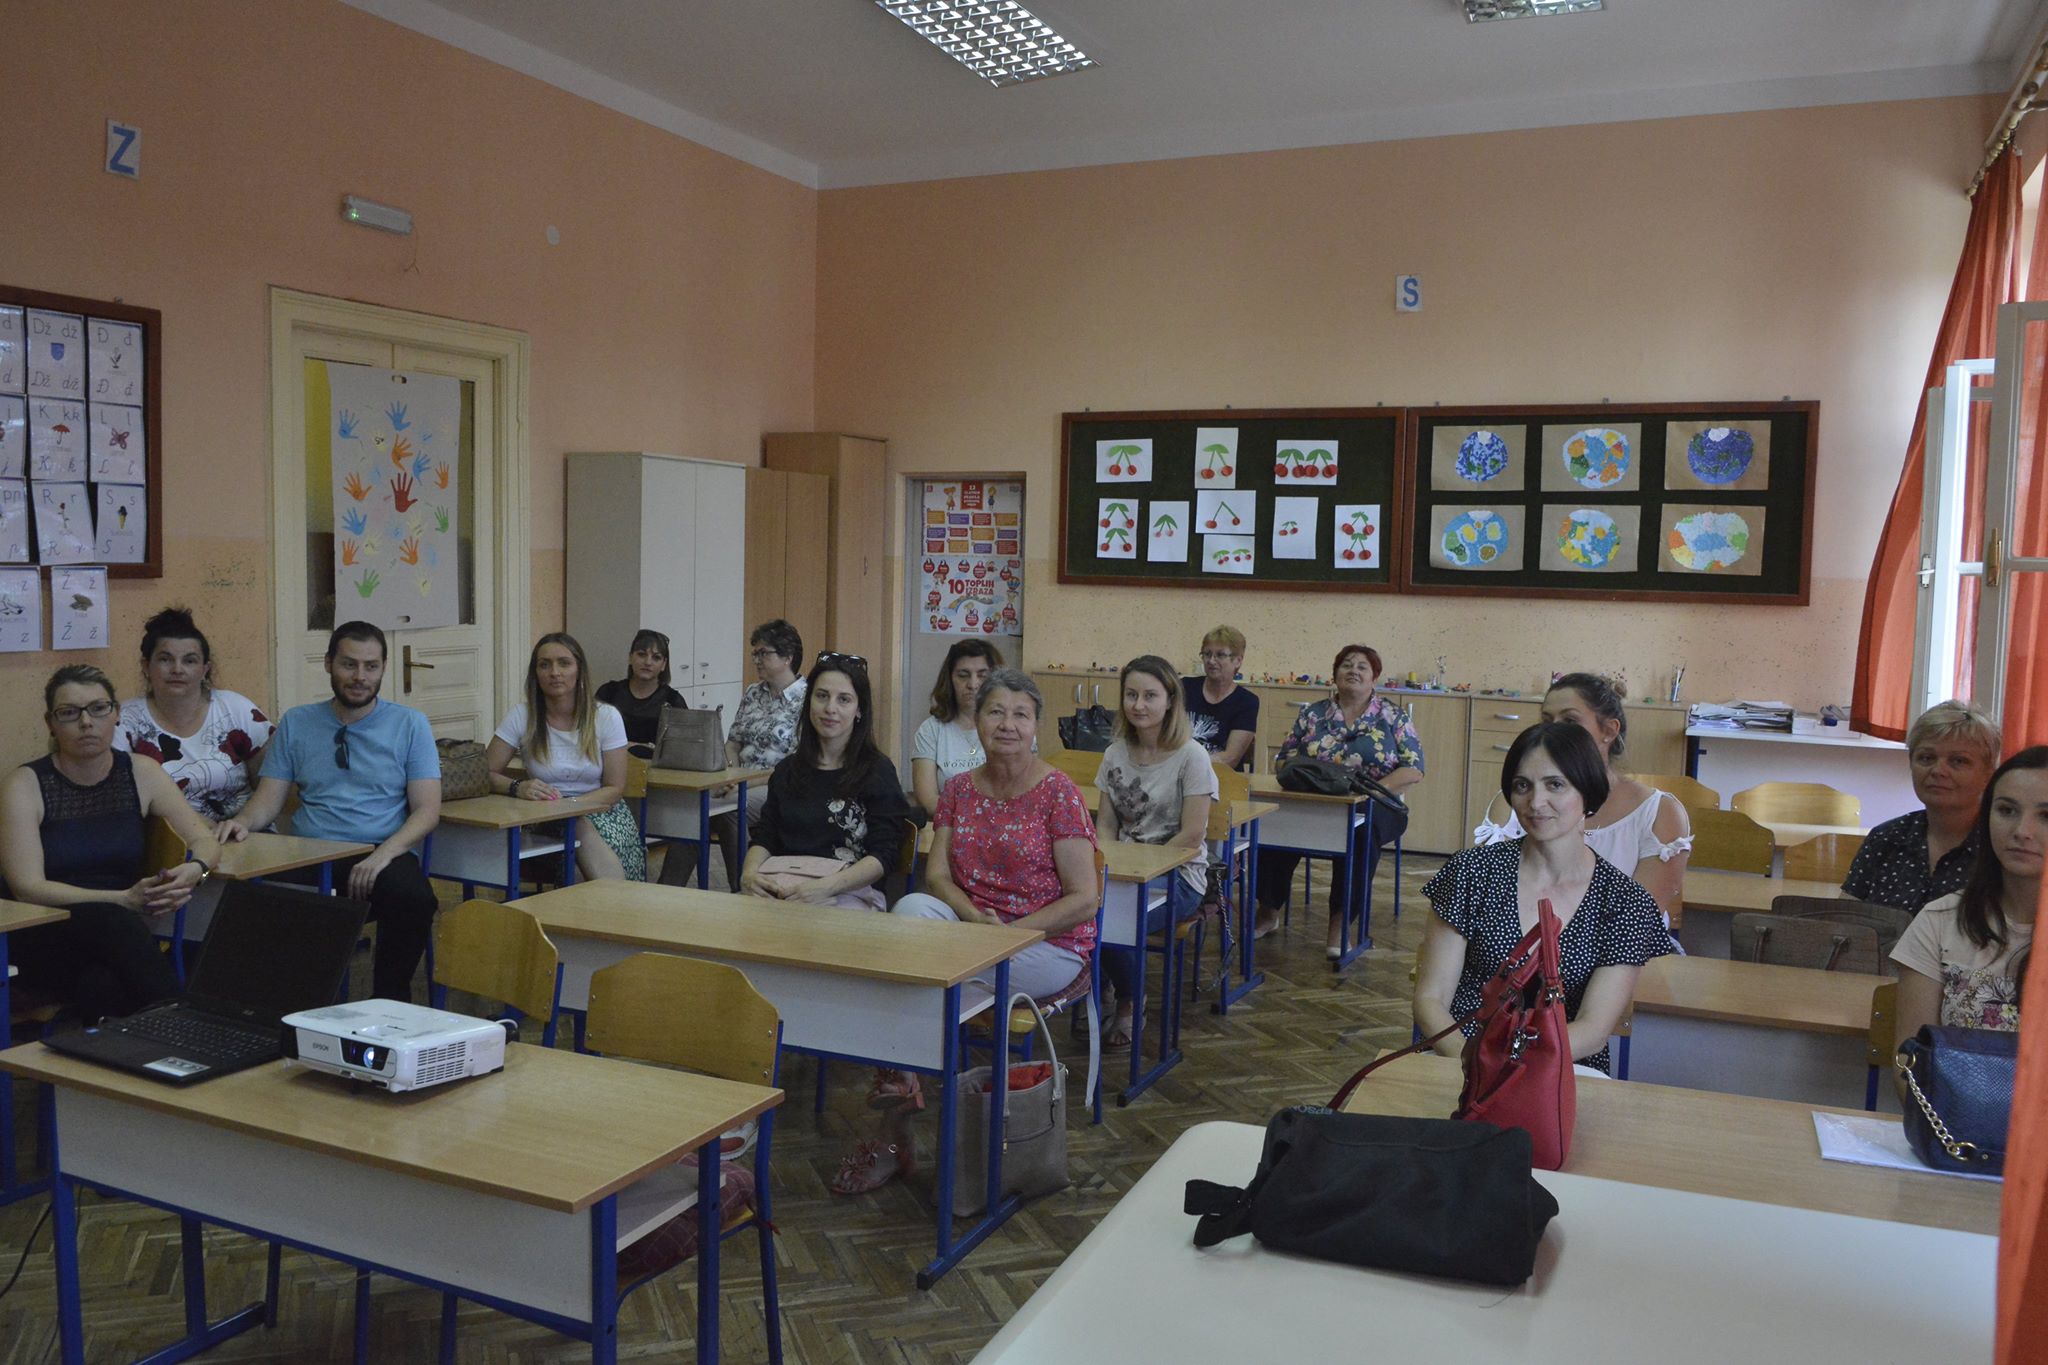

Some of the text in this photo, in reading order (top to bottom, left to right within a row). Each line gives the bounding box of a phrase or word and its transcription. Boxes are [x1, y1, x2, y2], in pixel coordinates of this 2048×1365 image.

[110, 126, 136, 176] Z
[1403, 278, 1418, 307] S
[2, 315, 12, 330] d
[33, 318, 78, 339] Dž dž
[39, 405, 50, 419] K
[100, 409, 108, 425] L
[43, 489, 54, 505] R
[106, 489, 114, 505] S
[948, 579, 964, 594] 10
[312, 1042, 330, 1052] EPSON
